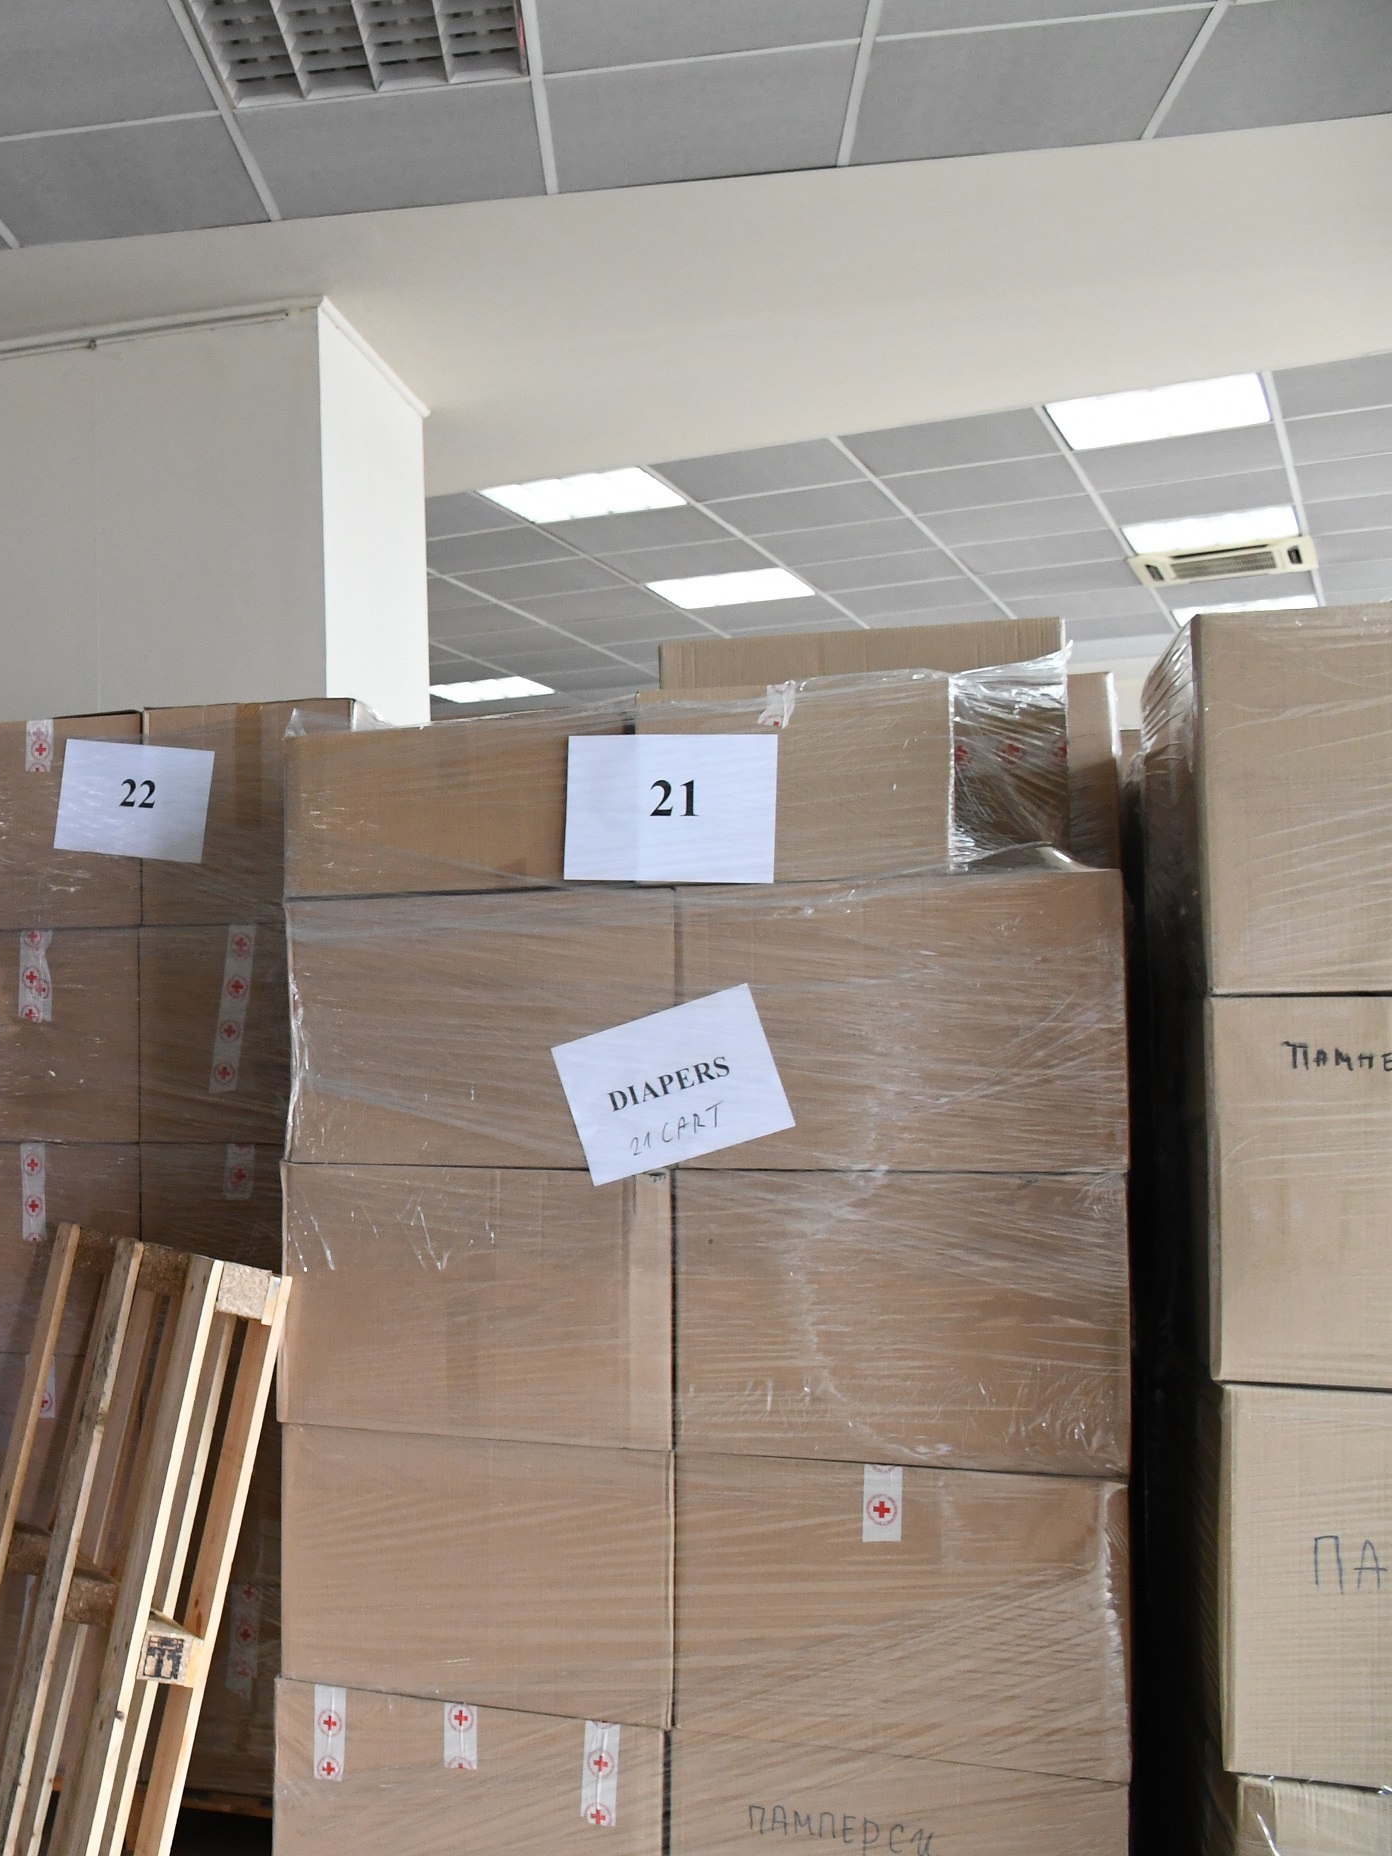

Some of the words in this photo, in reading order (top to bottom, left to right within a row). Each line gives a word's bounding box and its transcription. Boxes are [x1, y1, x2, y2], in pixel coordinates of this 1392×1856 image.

[119, 778, 156, 809] 22
[649, 779, 699, 817] 21
[607, 1056, 730, 1112] DIAPERS
[629, 1131, 651, 1156] 21
[661, 1100, 724, 1143] CART
[1314, 1535, 1388, 1594] ПА
[748, 1805, 933, 1856] ПАМПЕРСИ
